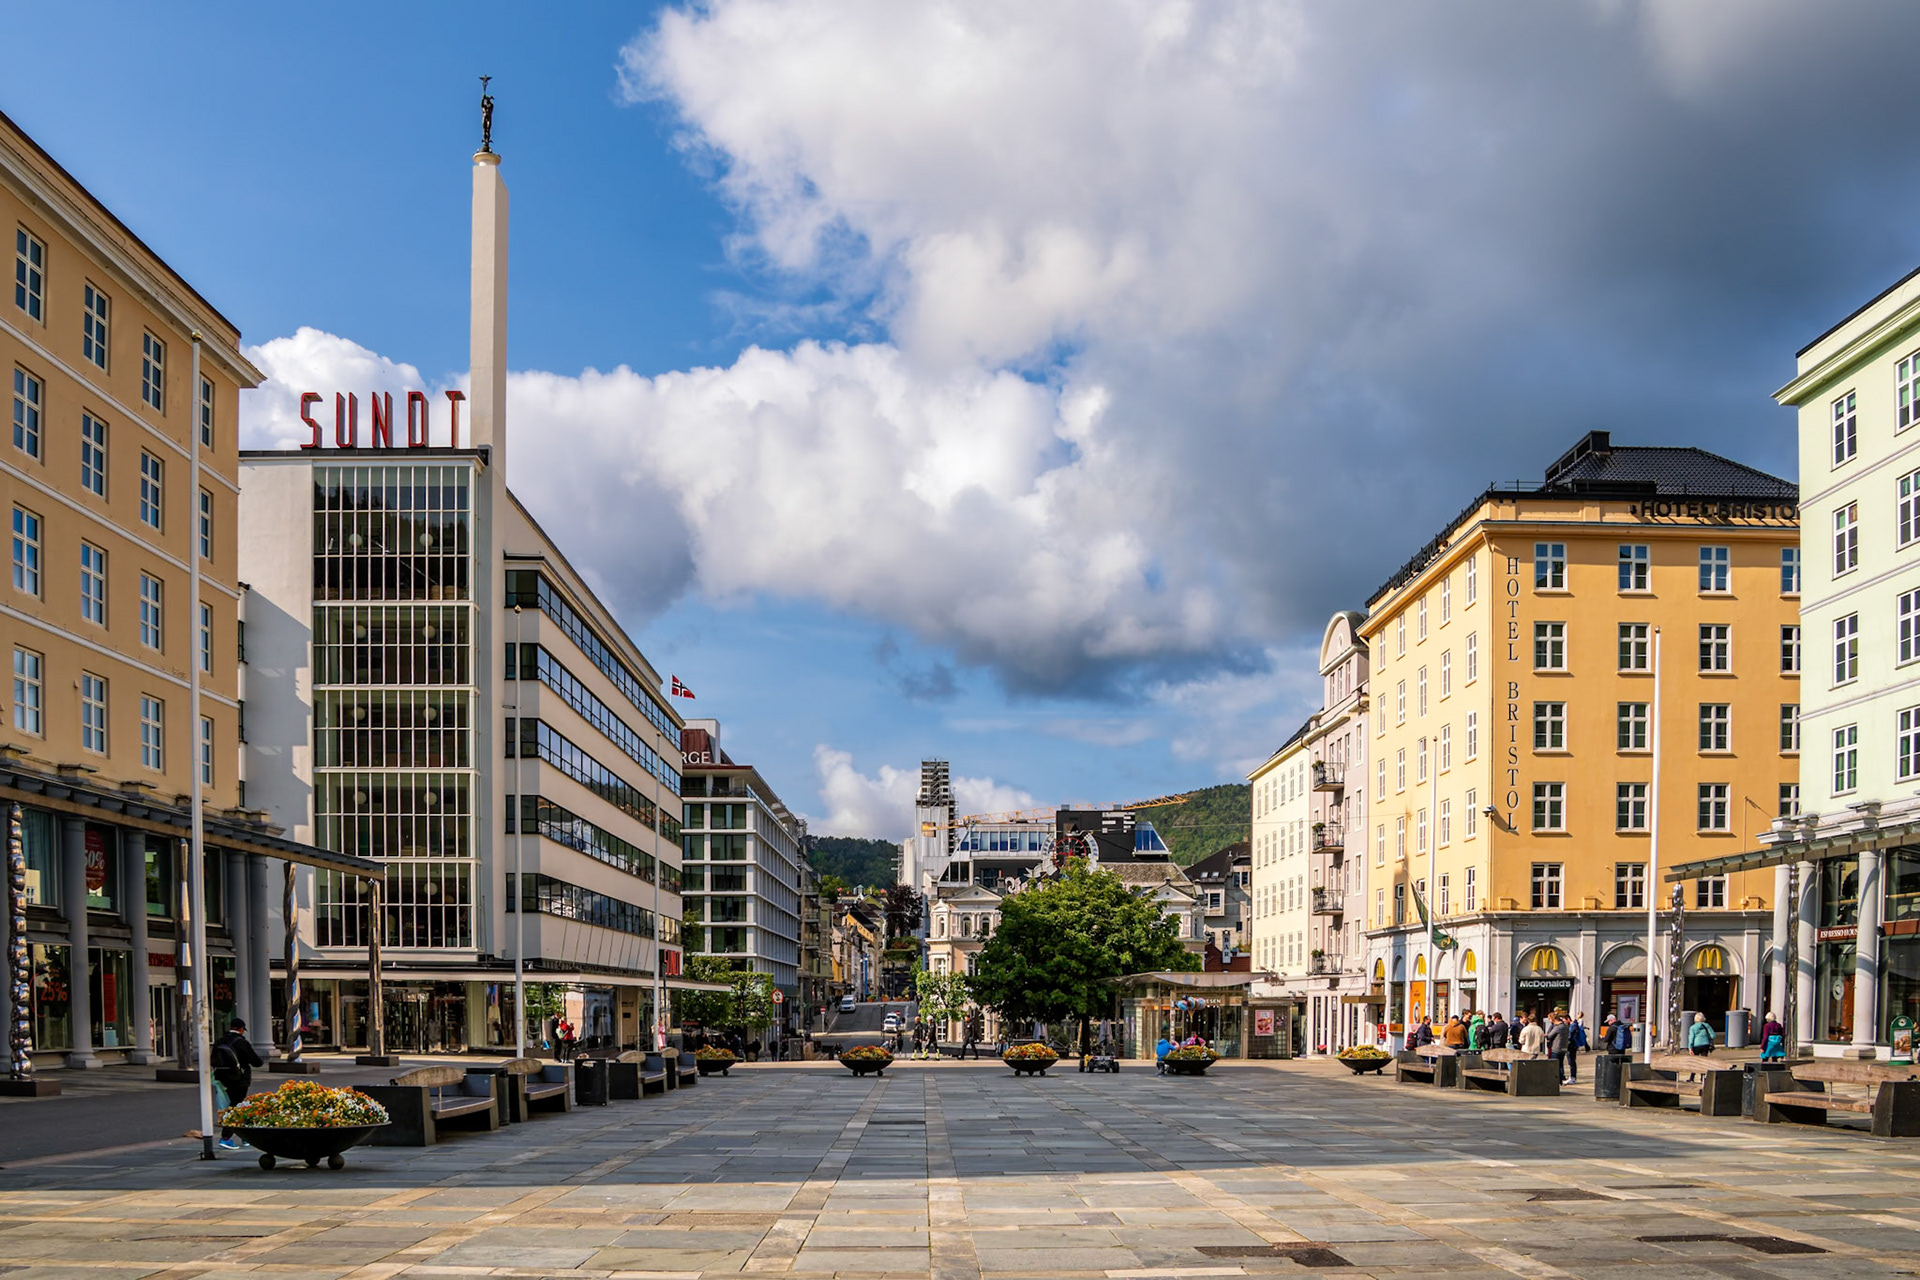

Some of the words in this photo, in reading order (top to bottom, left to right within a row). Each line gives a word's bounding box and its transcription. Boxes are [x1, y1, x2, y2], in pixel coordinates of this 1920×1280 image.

[300, 390, 466, 449] SUNDT
[1641, 500, 1713, 518] HOTEL
[1717, 501, 1799, 520] BRISTO
[1506, 557, 1520, 662] HOTEL
[1506, 681, 1520, 833] BRISTOL
[41, 982, 67, 1001] 25%
[1519, 979, 1571, 989] McDonald's
